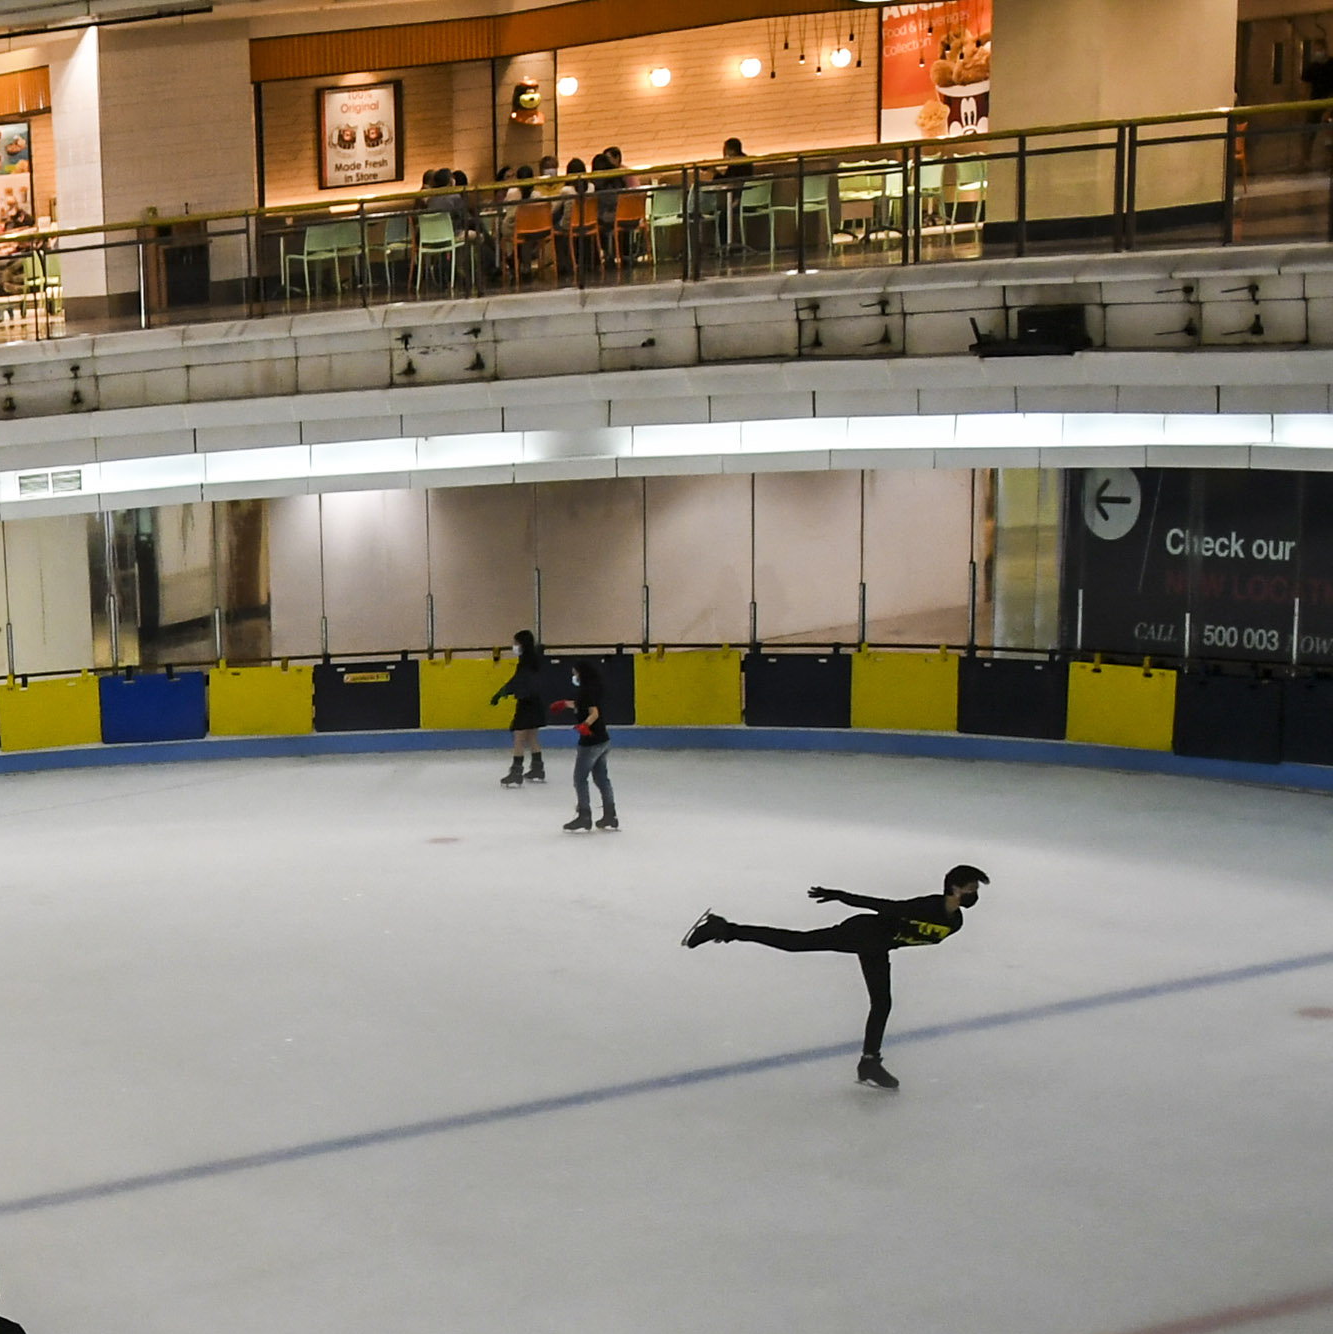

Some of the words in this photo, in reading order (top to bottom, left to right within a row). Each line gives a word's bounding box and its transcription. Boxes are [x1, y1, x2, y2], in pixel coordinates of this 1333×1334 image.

[341, 101, 379, 114] Original
[334, 162, 362, 172] Made
[365, 158, 388, 169] Fresh
[356, 172, 379, 182] Store
[1165, 528, 1245, 559] Check
[1252, 538, 1296, 561] our
[1134, 622, 1177, 642] CALL
[1203, 625, 1238, 648] 500
[1243, 628, 1279, 651] 003
